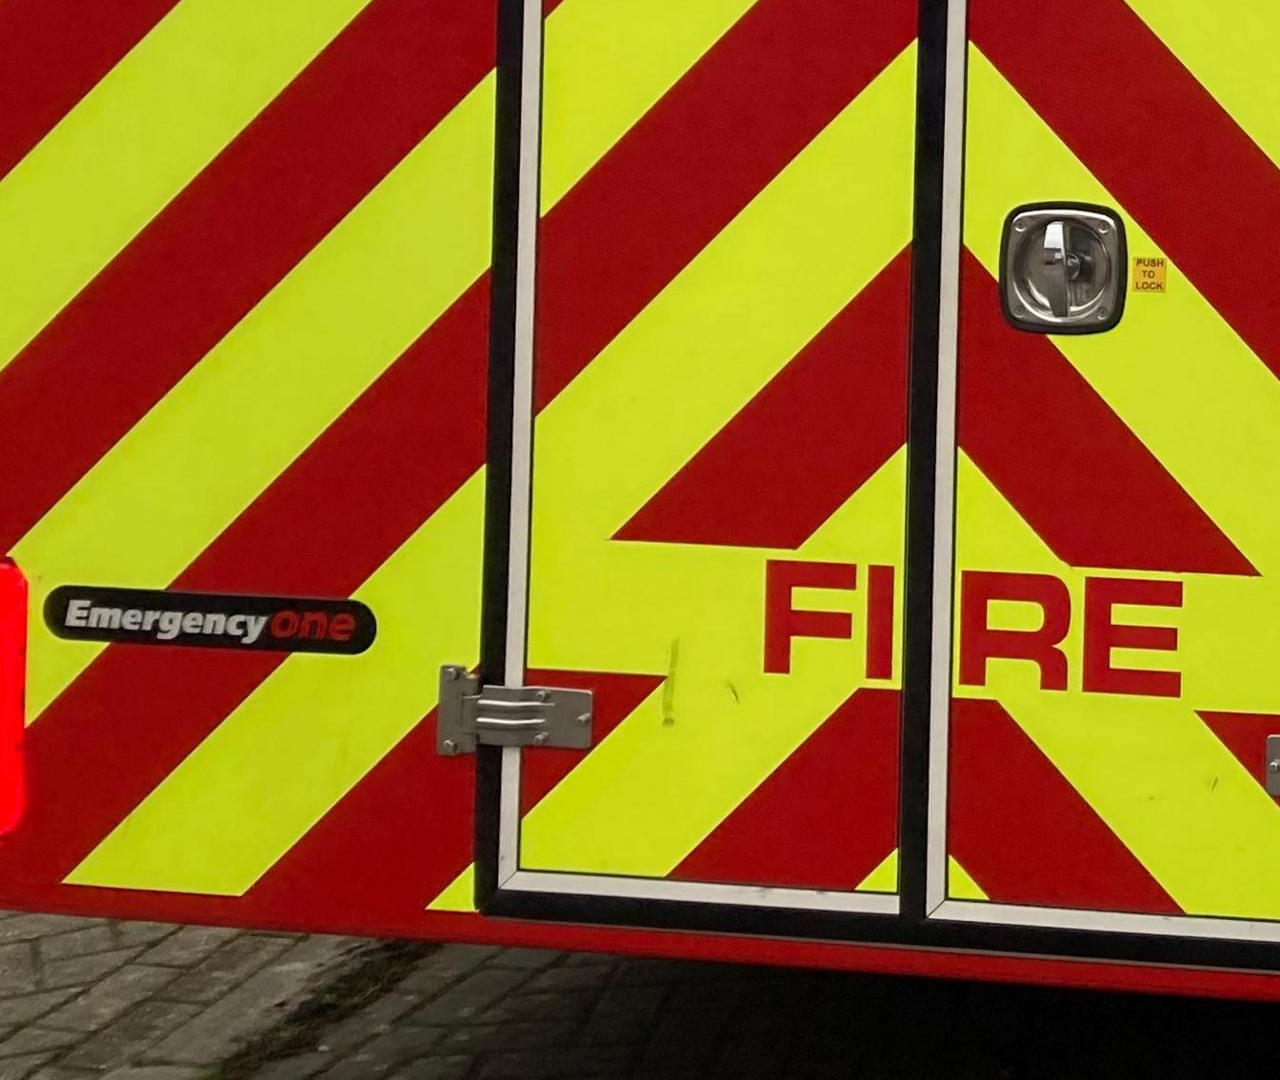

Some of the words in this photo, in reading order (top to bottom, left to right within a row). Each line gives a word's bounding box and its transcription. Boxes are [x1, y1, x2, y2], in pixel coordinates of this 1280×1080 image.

[1136, 258, 1164, 267] PUSH
[1142, 270, 1155, 278] TO
[1135, 281, 1164, 290] LOCK
[764, 559, 1183, 697] FIRE
